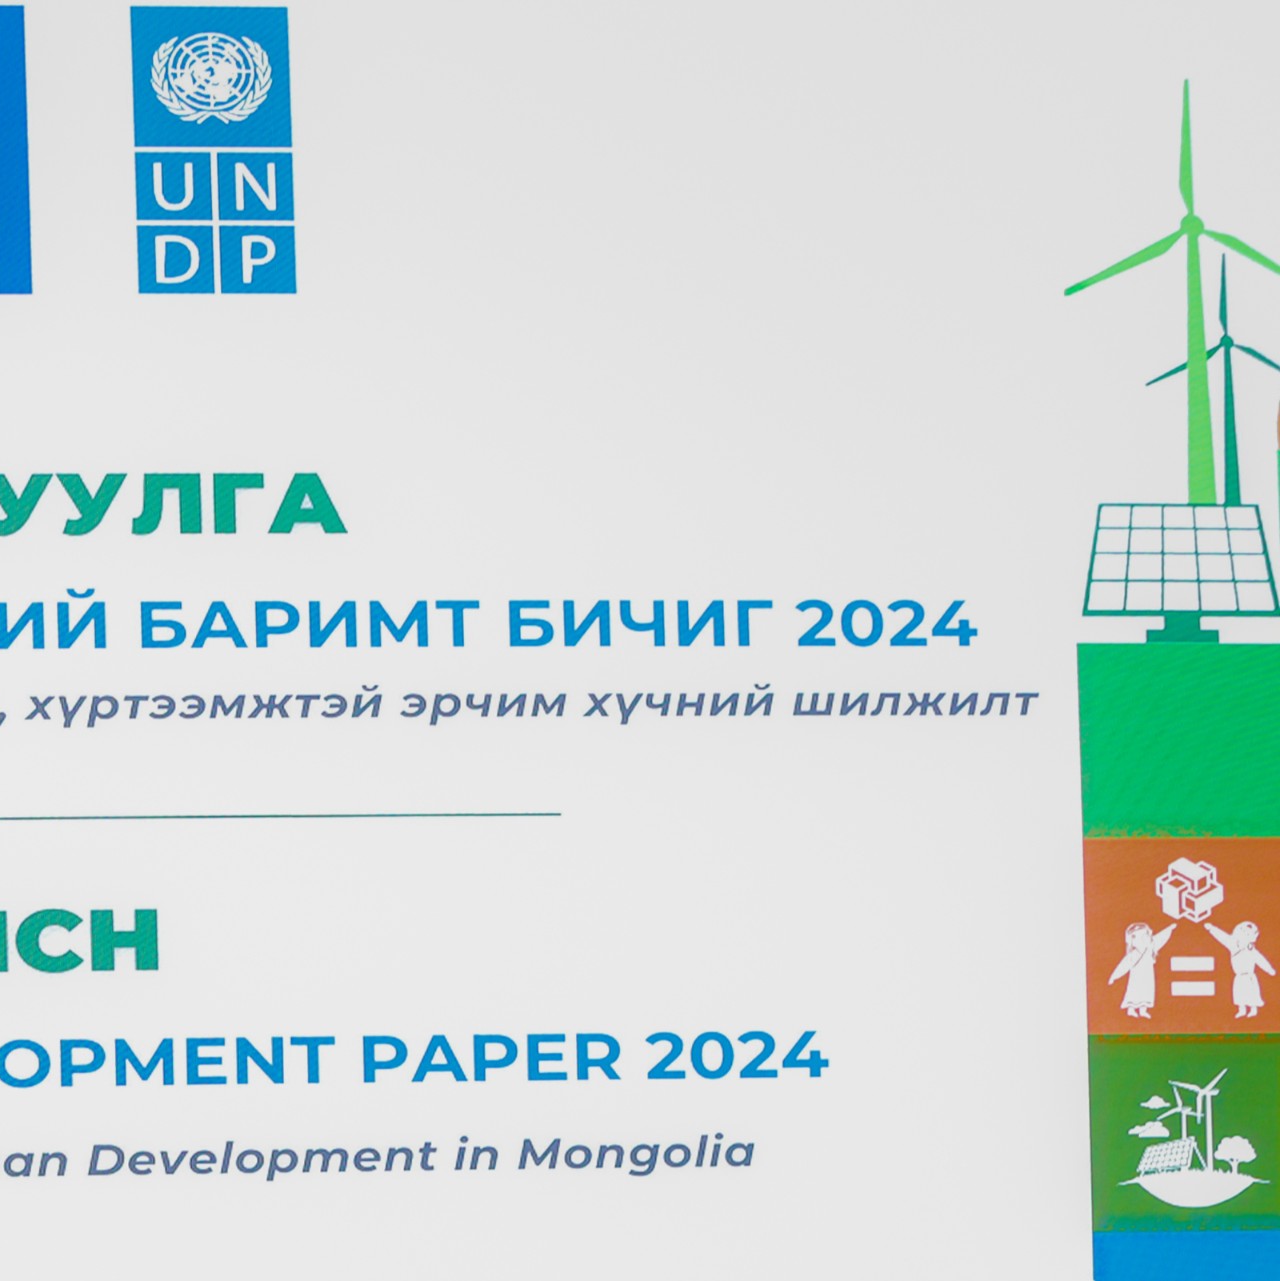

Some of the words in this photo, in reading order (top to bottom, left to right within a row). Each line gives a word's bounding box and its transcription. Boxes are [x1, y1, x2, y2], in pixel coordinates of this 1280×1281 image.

[140, 600, 482, 650] БАРИМТ
[509, 599, 775, 649] БИЧИГ
[796, 599, 980, 649] 2024
[25, 685, 384, 730] хүртээмжтэй
[401, 693, 568, 727] эрчим
[584, 684, 776, 727] хүчний
[793, 691, 1041, 719] шилжилт
[363, 1033, 623, 1085] PAPER
[645, 1030, 831, 1082] 2024
[88, 1141, 439, 1183] Development
[455, 1136, 500, 1172] in
[518, 1133, 756, 1178] Mongolia
